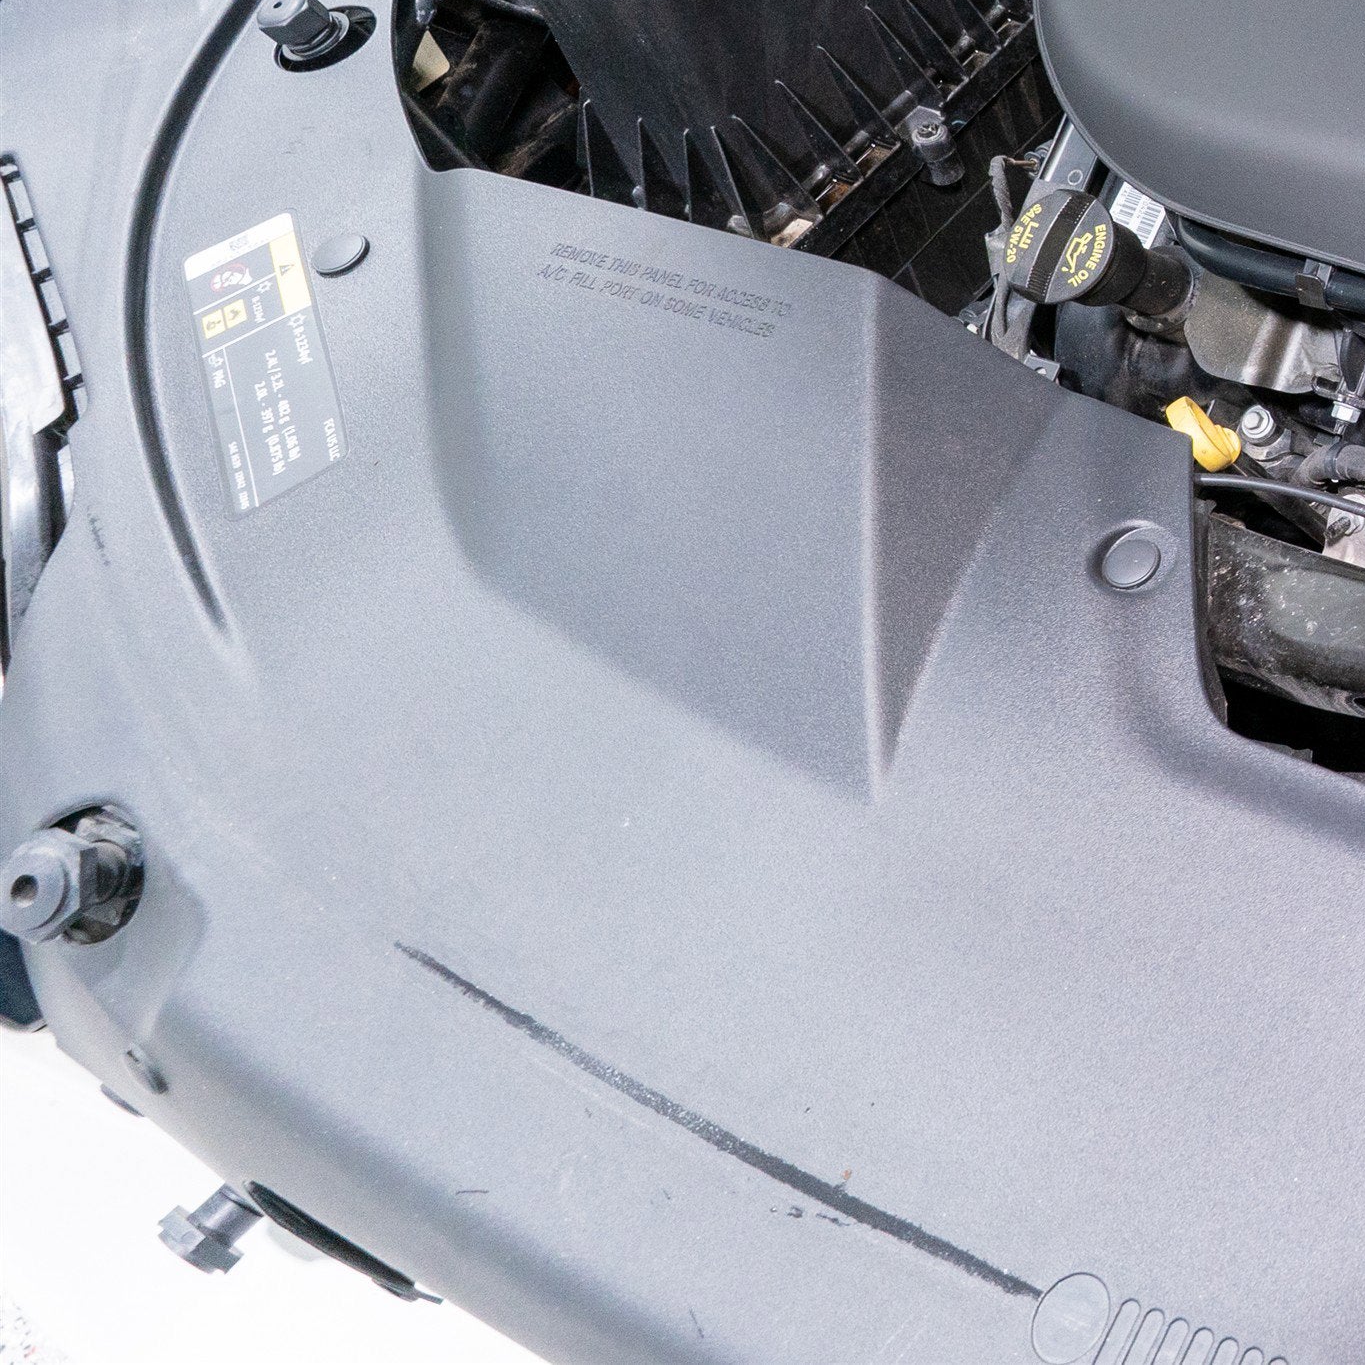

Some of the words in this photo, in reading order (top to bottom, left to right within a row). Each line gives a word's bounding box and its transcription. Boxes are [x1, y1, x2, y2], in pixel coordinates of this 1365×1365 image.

[1020, 203, 1043, 224] SAE
[1006, 224, 1024, 263] 5W-20
[1085, 223, 1107, 271] ENGINE
[549, 242, 609, 268] REMOVE
[605, 257, 641, 277] THIS
[639, 266, 687, 288] PANEL
[684, 278, 718, 297] FOR
[712, 285, 772, 312] ACCESS
[769, 300, 793, 317] TO
[1067, 270, 1089, 288] OIL
[536, 260, 570, 283] A/C
[568, 270, 600, 290] FILL
[599, 279, 639, 301] PORT
[638, 289, 665, 307] ON
[661, 296, 707, 320] SOME
[705, 308, 777, 338] VEHICLES
[291, 324, 313, 367] R-1234yf
[212, 368, 225, 388] PAG
[260, 406, 273, 425] 397
[322, 417, 335, 437] FCA
[325, 433, 337, 448] US
[327, 444, 340, 462] LLC
